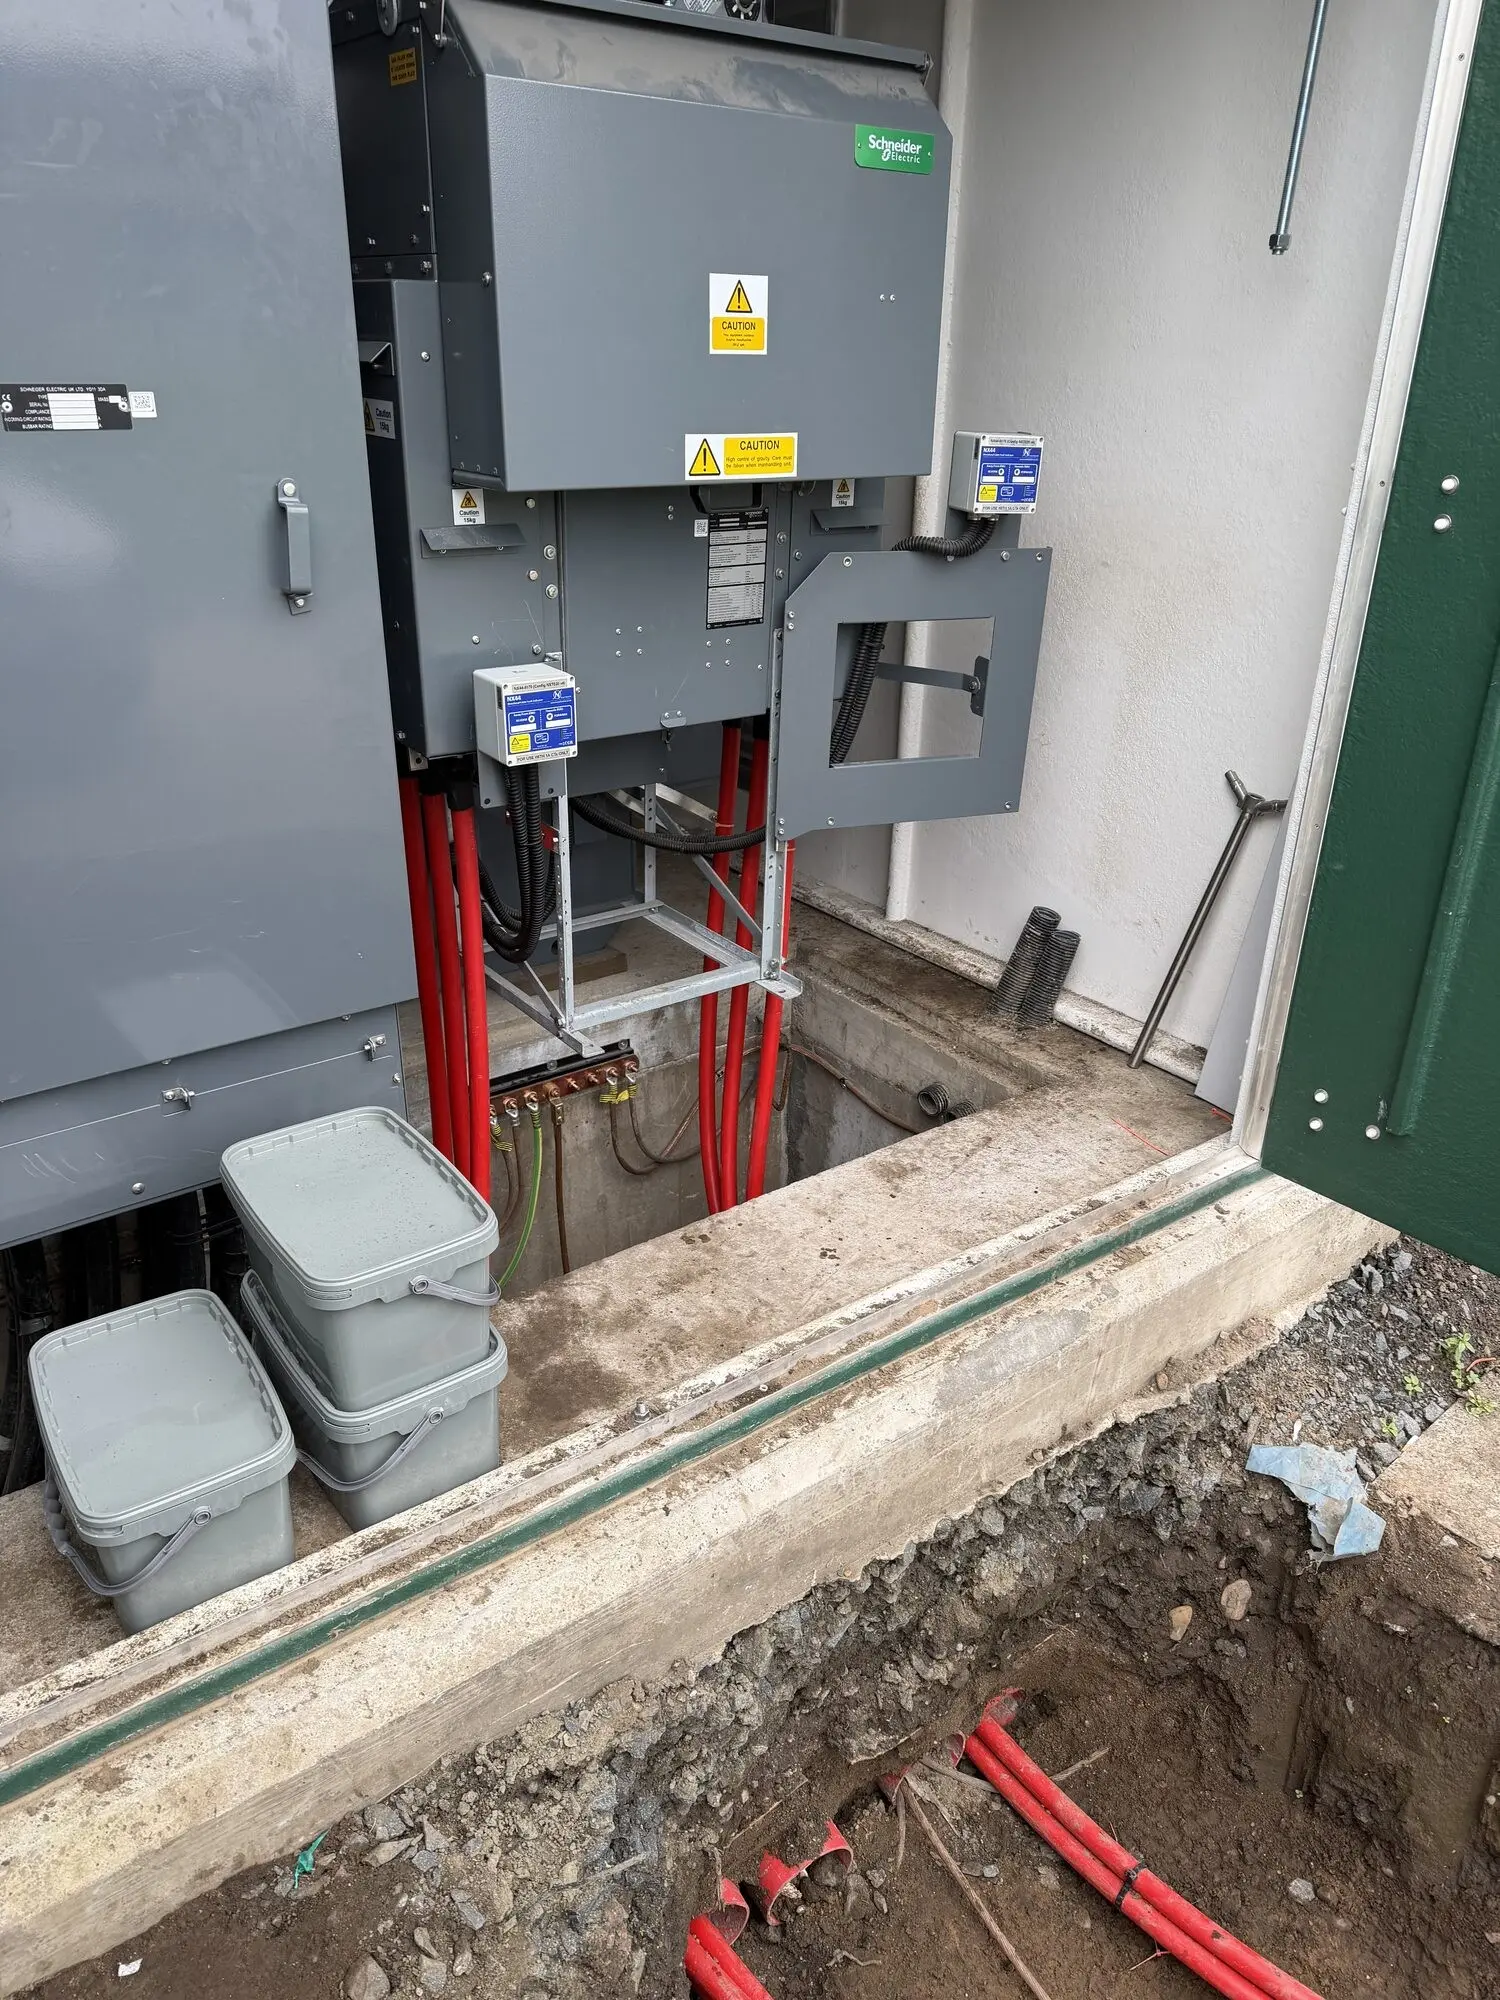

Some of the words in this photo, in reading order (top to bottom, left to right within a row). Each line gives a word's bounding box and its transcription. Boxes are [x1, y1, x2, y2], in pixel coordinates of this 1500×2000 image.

[868, 134, 922, 154] Schneider
[891, 151, 920, 164] Electric
[721, 321, 756, 331] CAUTION
[376, 408, 391, 418] Caution
[740, 440, 780, 451] CAUTION
